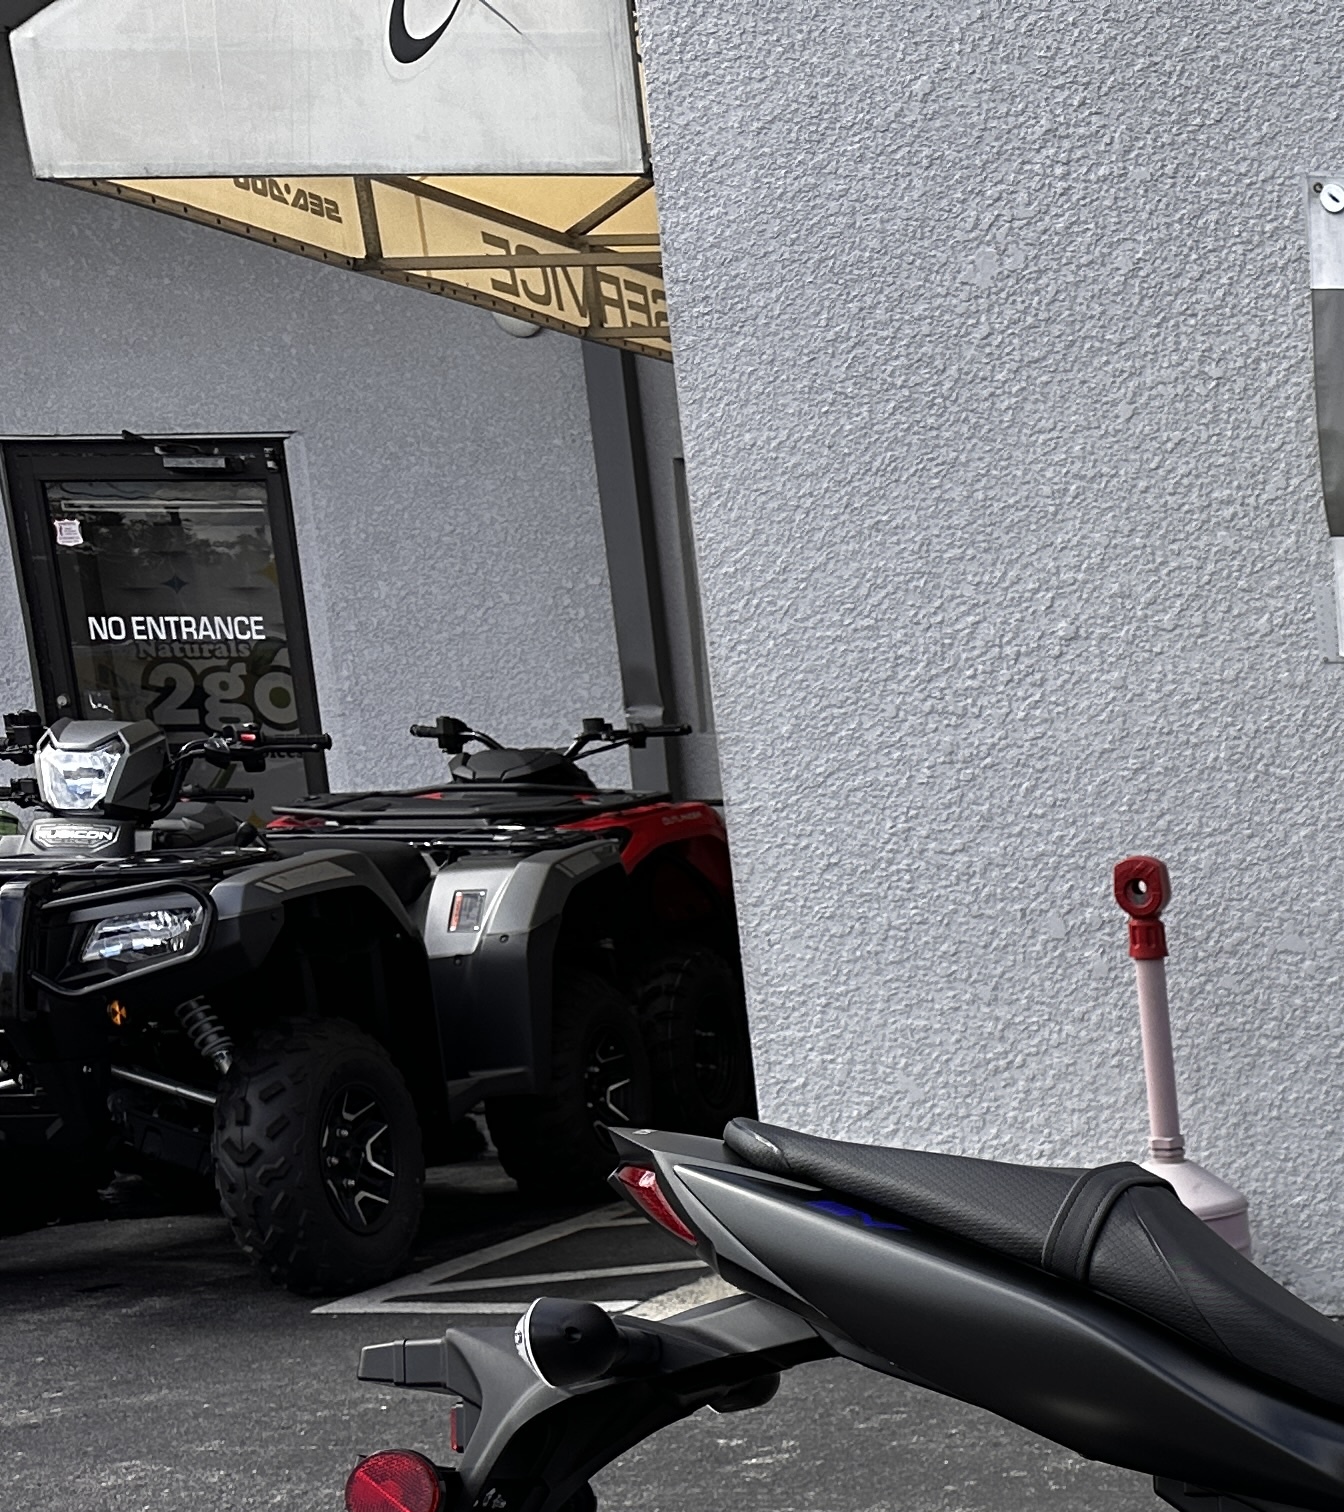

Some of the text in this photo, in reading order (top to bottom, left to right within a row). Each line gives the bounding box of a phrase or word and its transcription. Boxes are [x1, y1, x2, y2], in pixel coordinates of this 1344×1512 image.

[87, 616, 266, 640] NO ENTRANCE
[136, 640, 251, 660] Naturals
